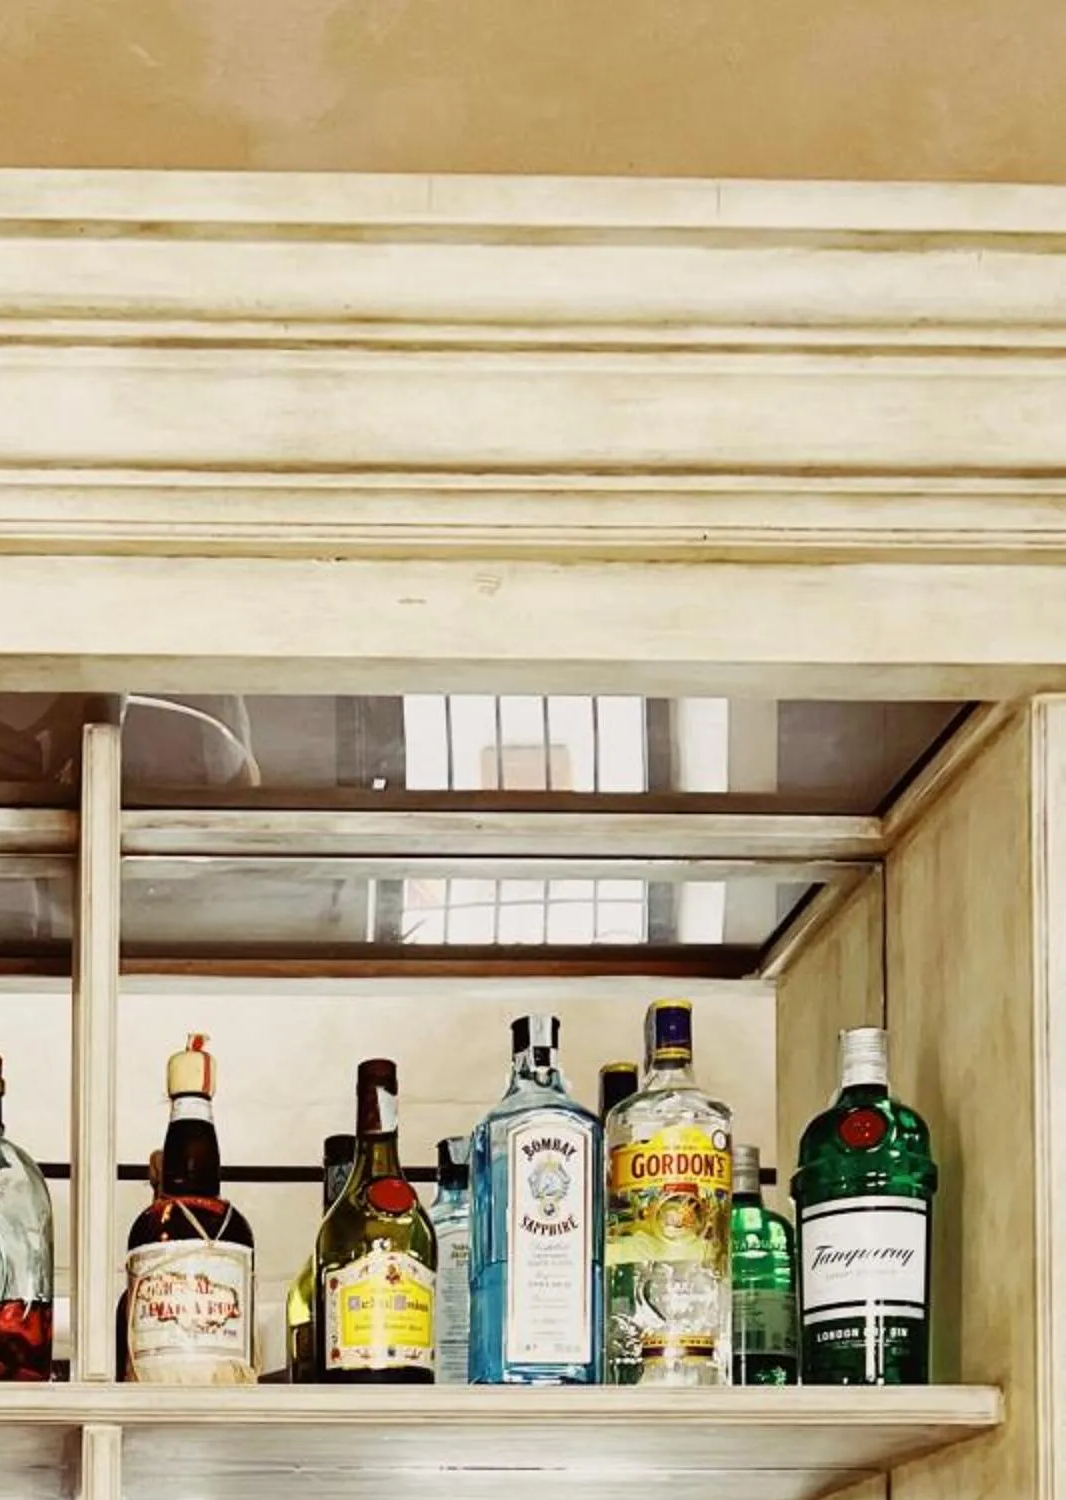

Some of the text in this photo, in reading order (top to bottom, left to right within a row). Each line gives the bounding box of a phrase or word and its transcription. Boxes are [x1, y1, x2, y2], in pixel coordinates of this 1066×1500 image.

[521, 1137, 578, 1161] BOMBAY
[631, 1153, 726, 1178] GORDON'S
[520, 1214, 580, 1237] SAPPHIRE
[811, 1245, 915, 1270] Tanqueray
[817, 1328, 860, 1342] LONDON
